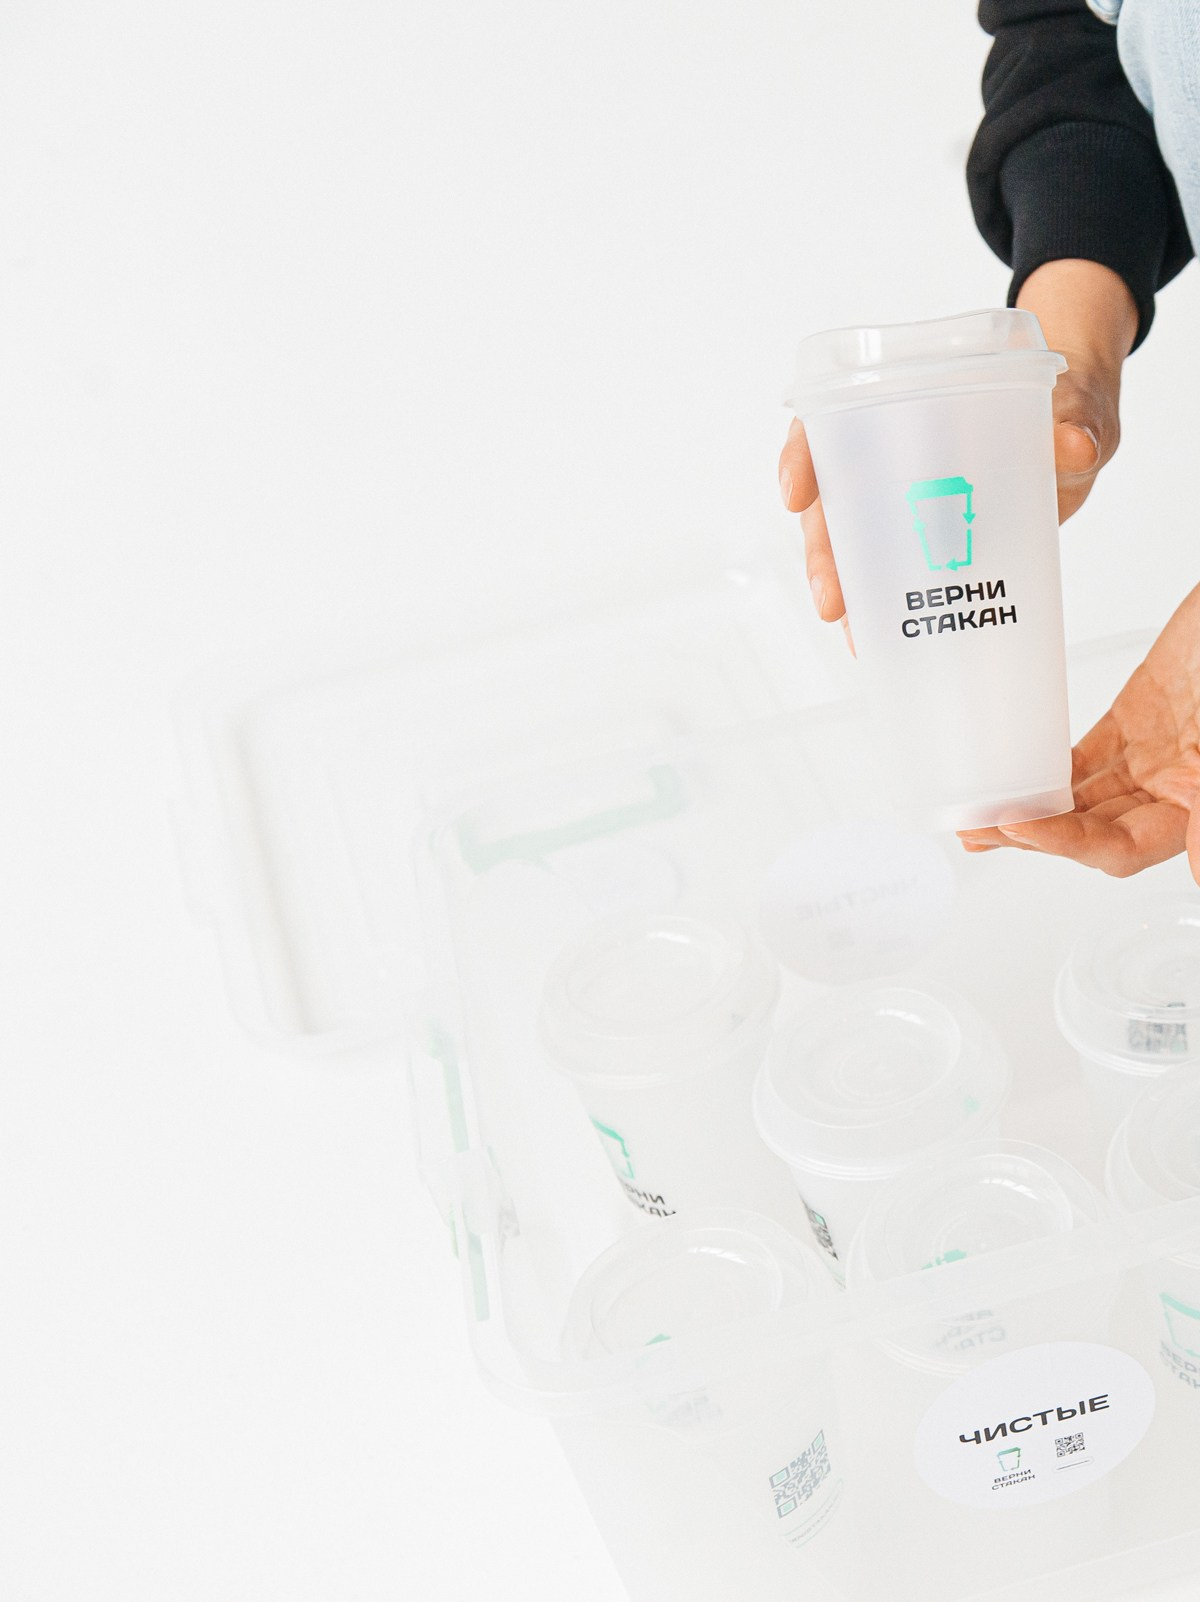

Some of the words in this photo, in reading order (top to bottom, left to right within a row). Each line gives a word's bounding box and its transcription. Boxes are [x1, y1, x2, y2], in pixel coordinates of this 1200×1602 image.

[905, 579, 1006, 611] ВЕРНИ
[901, 604, 1018, 638] СТАКАН
[958, 1393, 1110, 1445] ЧИСТЫЕ
[991, 1474, 1036, 1491] СТАКАН
[993, 1468, 1032, 1484] ВЕРНИ
